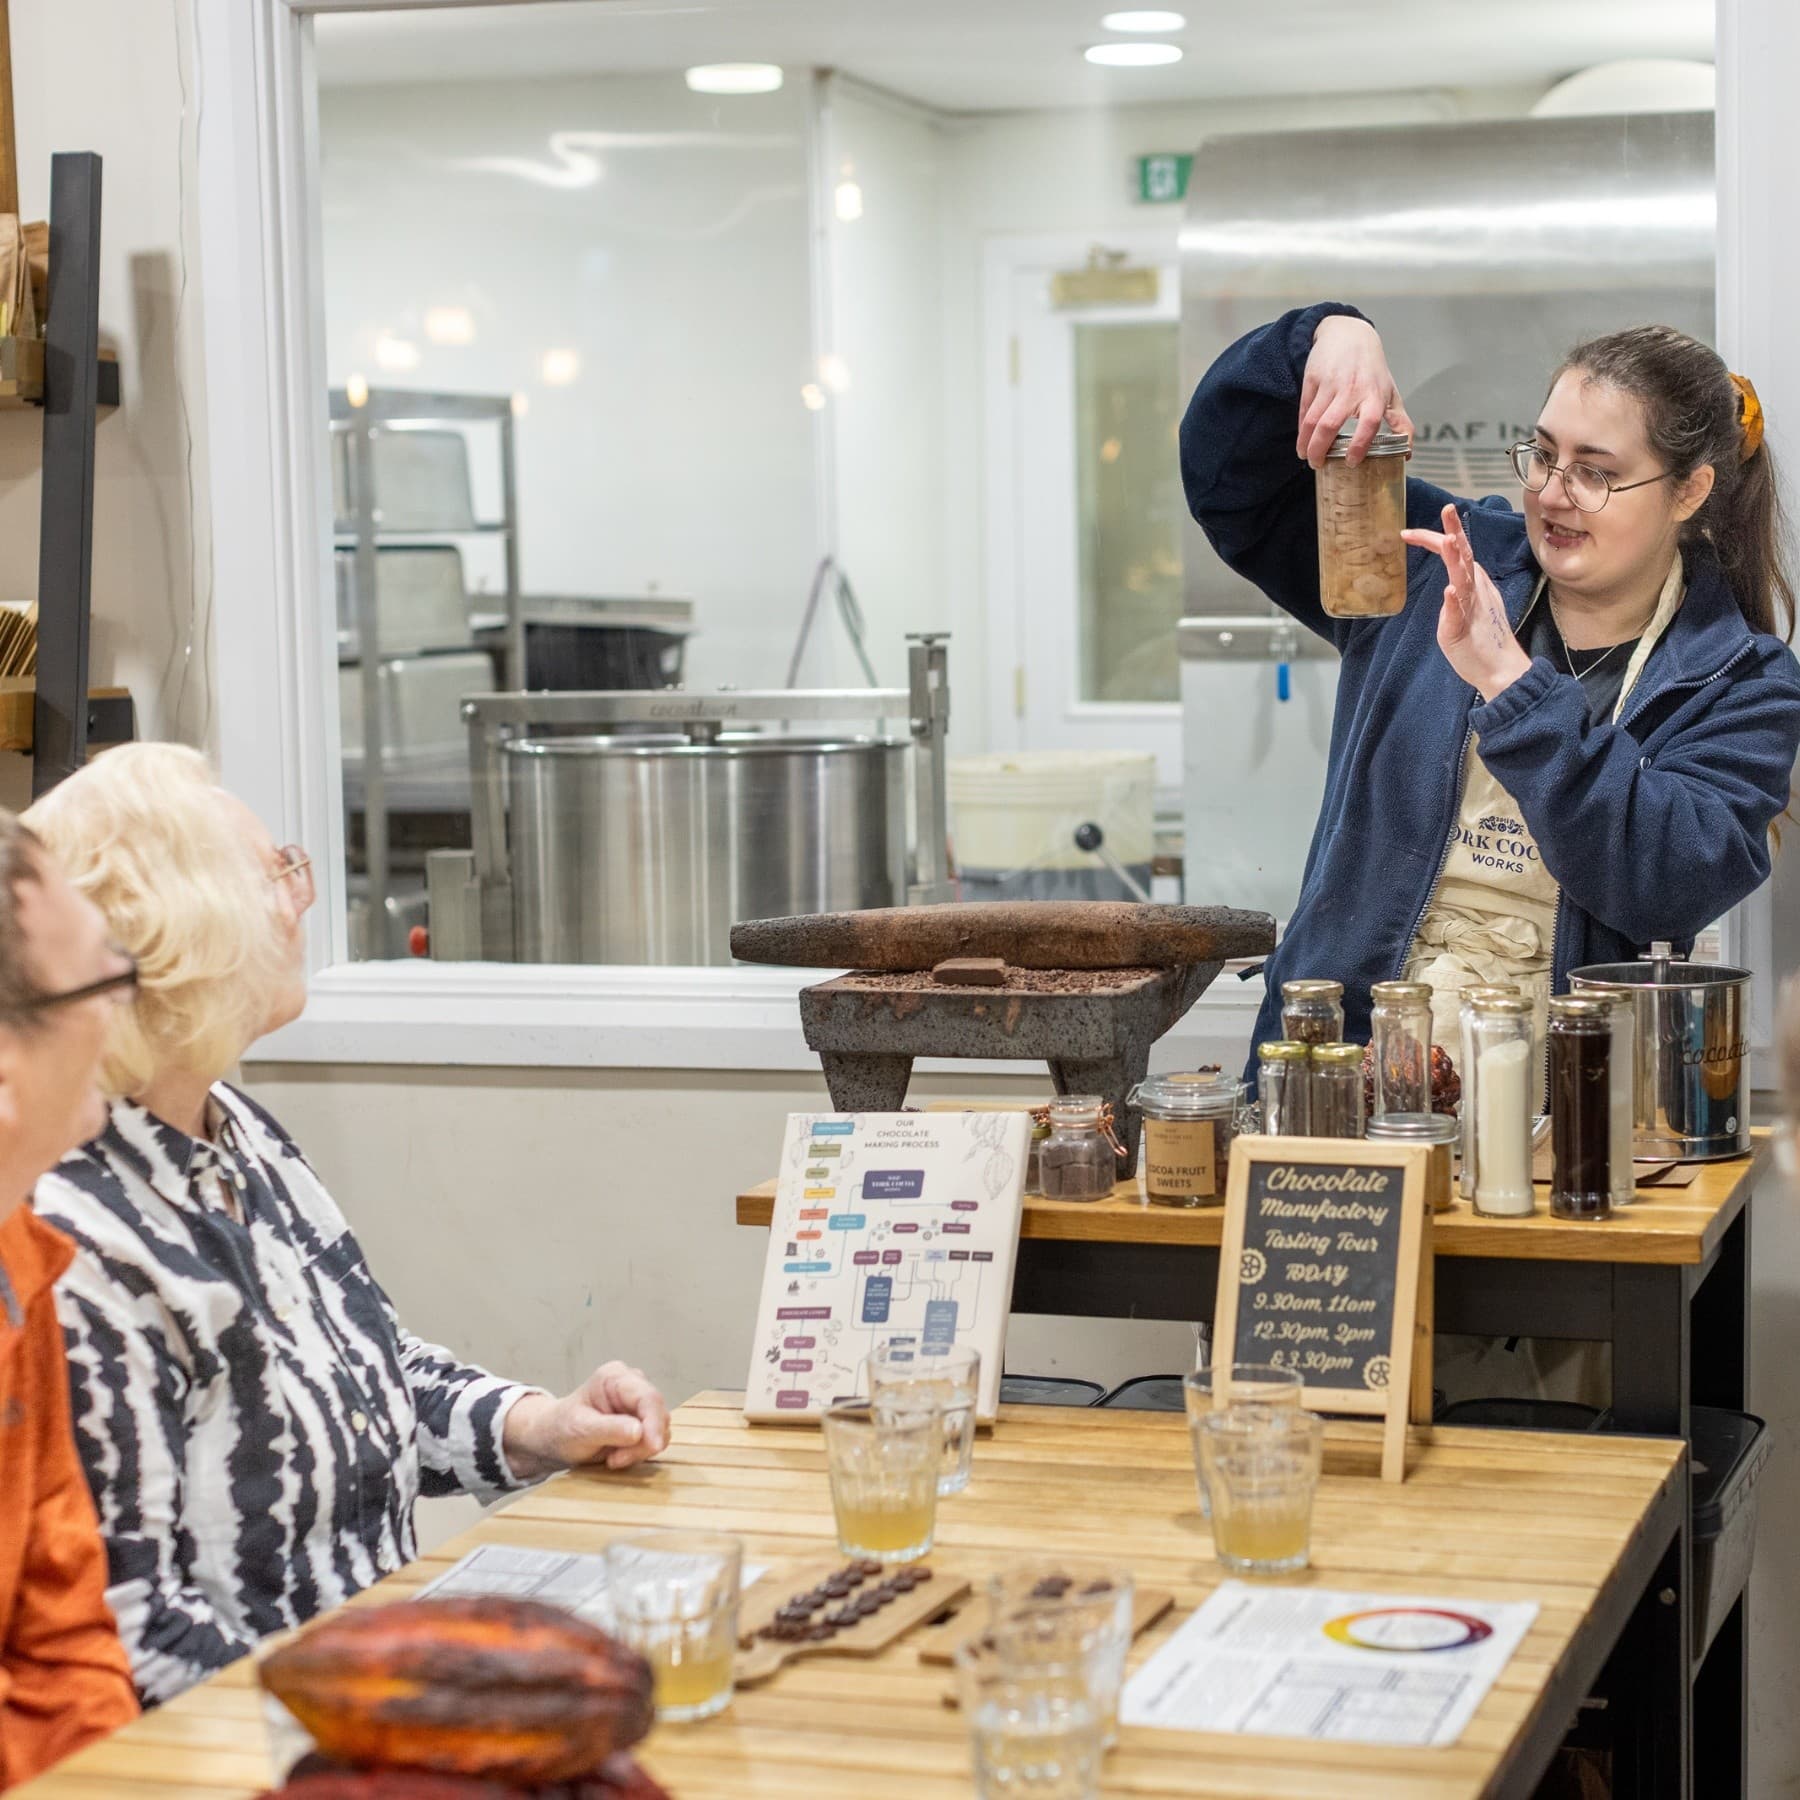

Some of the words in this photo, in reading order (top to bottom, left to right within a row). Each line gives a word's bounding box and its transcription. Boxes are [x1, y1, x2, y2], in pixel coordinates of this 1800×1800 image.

[1472, 852, 1524, 873] WORKS
[896, 1119, 915, 1127] OUR
[864, 1141, 899, 1149] MAKING
[901, 1140, 940, 1148] PROCESS
[876, 1130, 929, 1138] CHOCOLATE
[1175, 1165, 1206, 1177] FRUIT
[1266, 1166, 1389, 1193] Chocolate
[1156, 1177, 1192, 1188] SWEETS
[1259, 1197, 1389, 1226] Manufactory
[1265, 1229, 1331, 1256] Tasting
[1336, 1231, 1379, 1252] Tour
[1285, 1263, 1349, 1287] TODAY
[1252, 1292, 1323, 1313] 9.30am,
[1327, 1295, 1376, 1312] 11am
[1252, 1321, 1330, 1344] 12.30pm,
[1334, 1323, 1376, 1345] 2pm
[1269, 1350, 1284, 1368] &
[1287, 1350, 1354, 1374] 3.30pm
